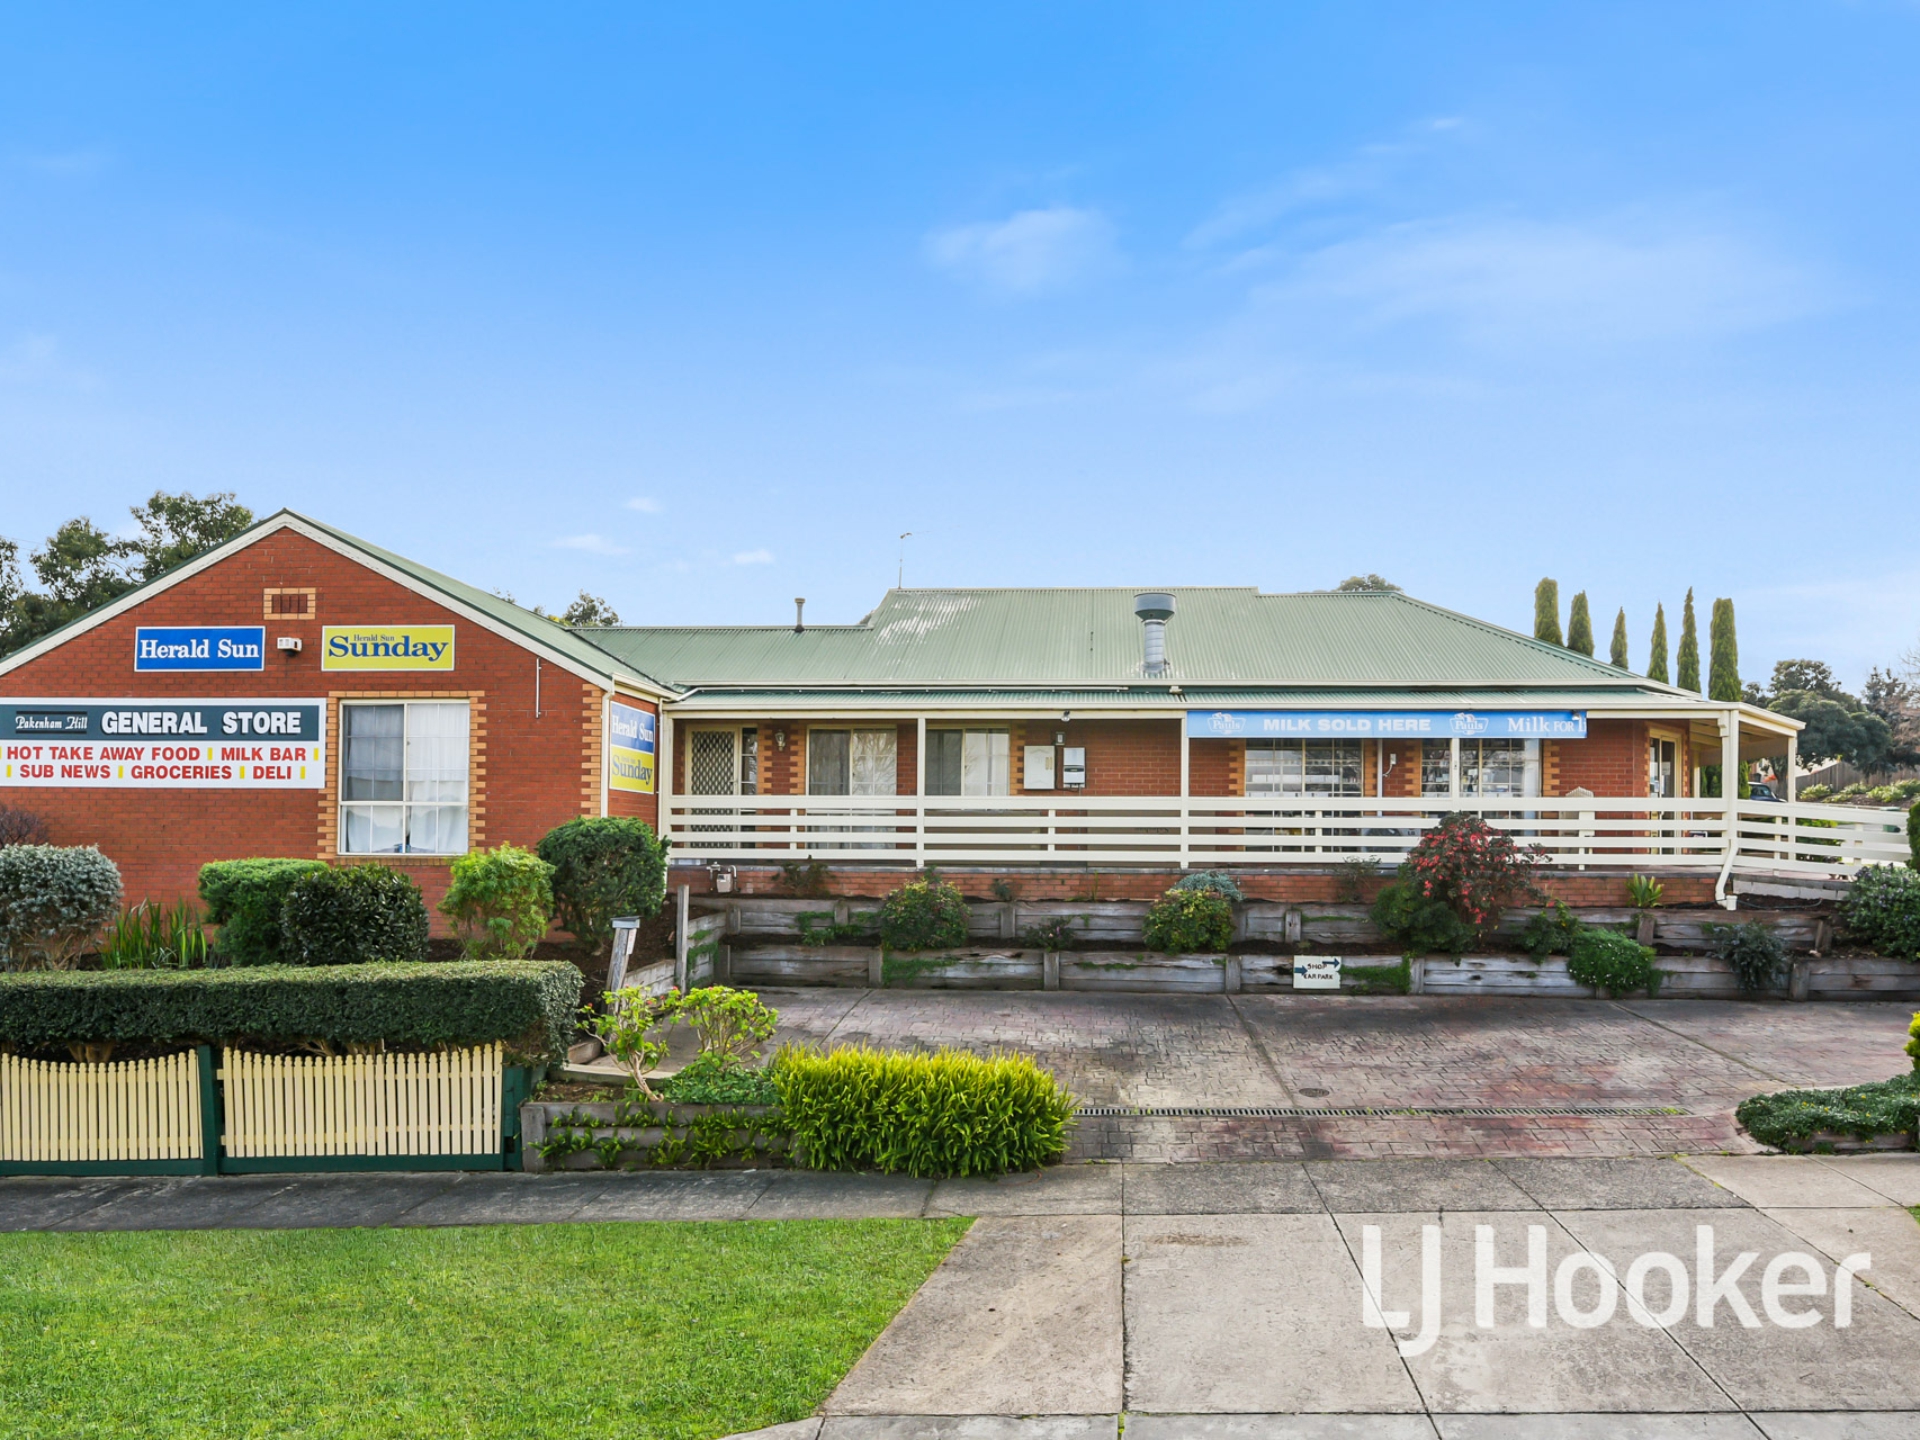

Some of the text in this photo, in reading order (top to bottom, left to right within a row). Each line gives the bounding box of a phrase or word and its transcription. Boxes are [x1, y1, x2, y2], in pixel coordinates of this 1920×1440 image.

[353, 634, 395, 642] Herald Sun
[139, 638, 260, 659] Herald Sun
[328, 635, 449, 662] Sunday
[15, 716, 88, 730] Pakenham Hill
[101, 711, 302, 735] GENERAL STORE
[612, 714, 654, 743] Herald Sun
[1212, 720, 1241, 731] Pauls
[1263, 719, 1432, 731] MILK SOLD HERE
[1455, 719, 1484, 731] Pauls
[1507, 716, 1551, 732] Milk
[1554, 721, 1575, 732] FOR
[7, 746, 307, 761] HOT TAKE AWAY FOOD MILK BAR
[20, 764, 292, 780] SUB NEWS GROCERIES DELI
[611, 754, 653, 785] Sunday
